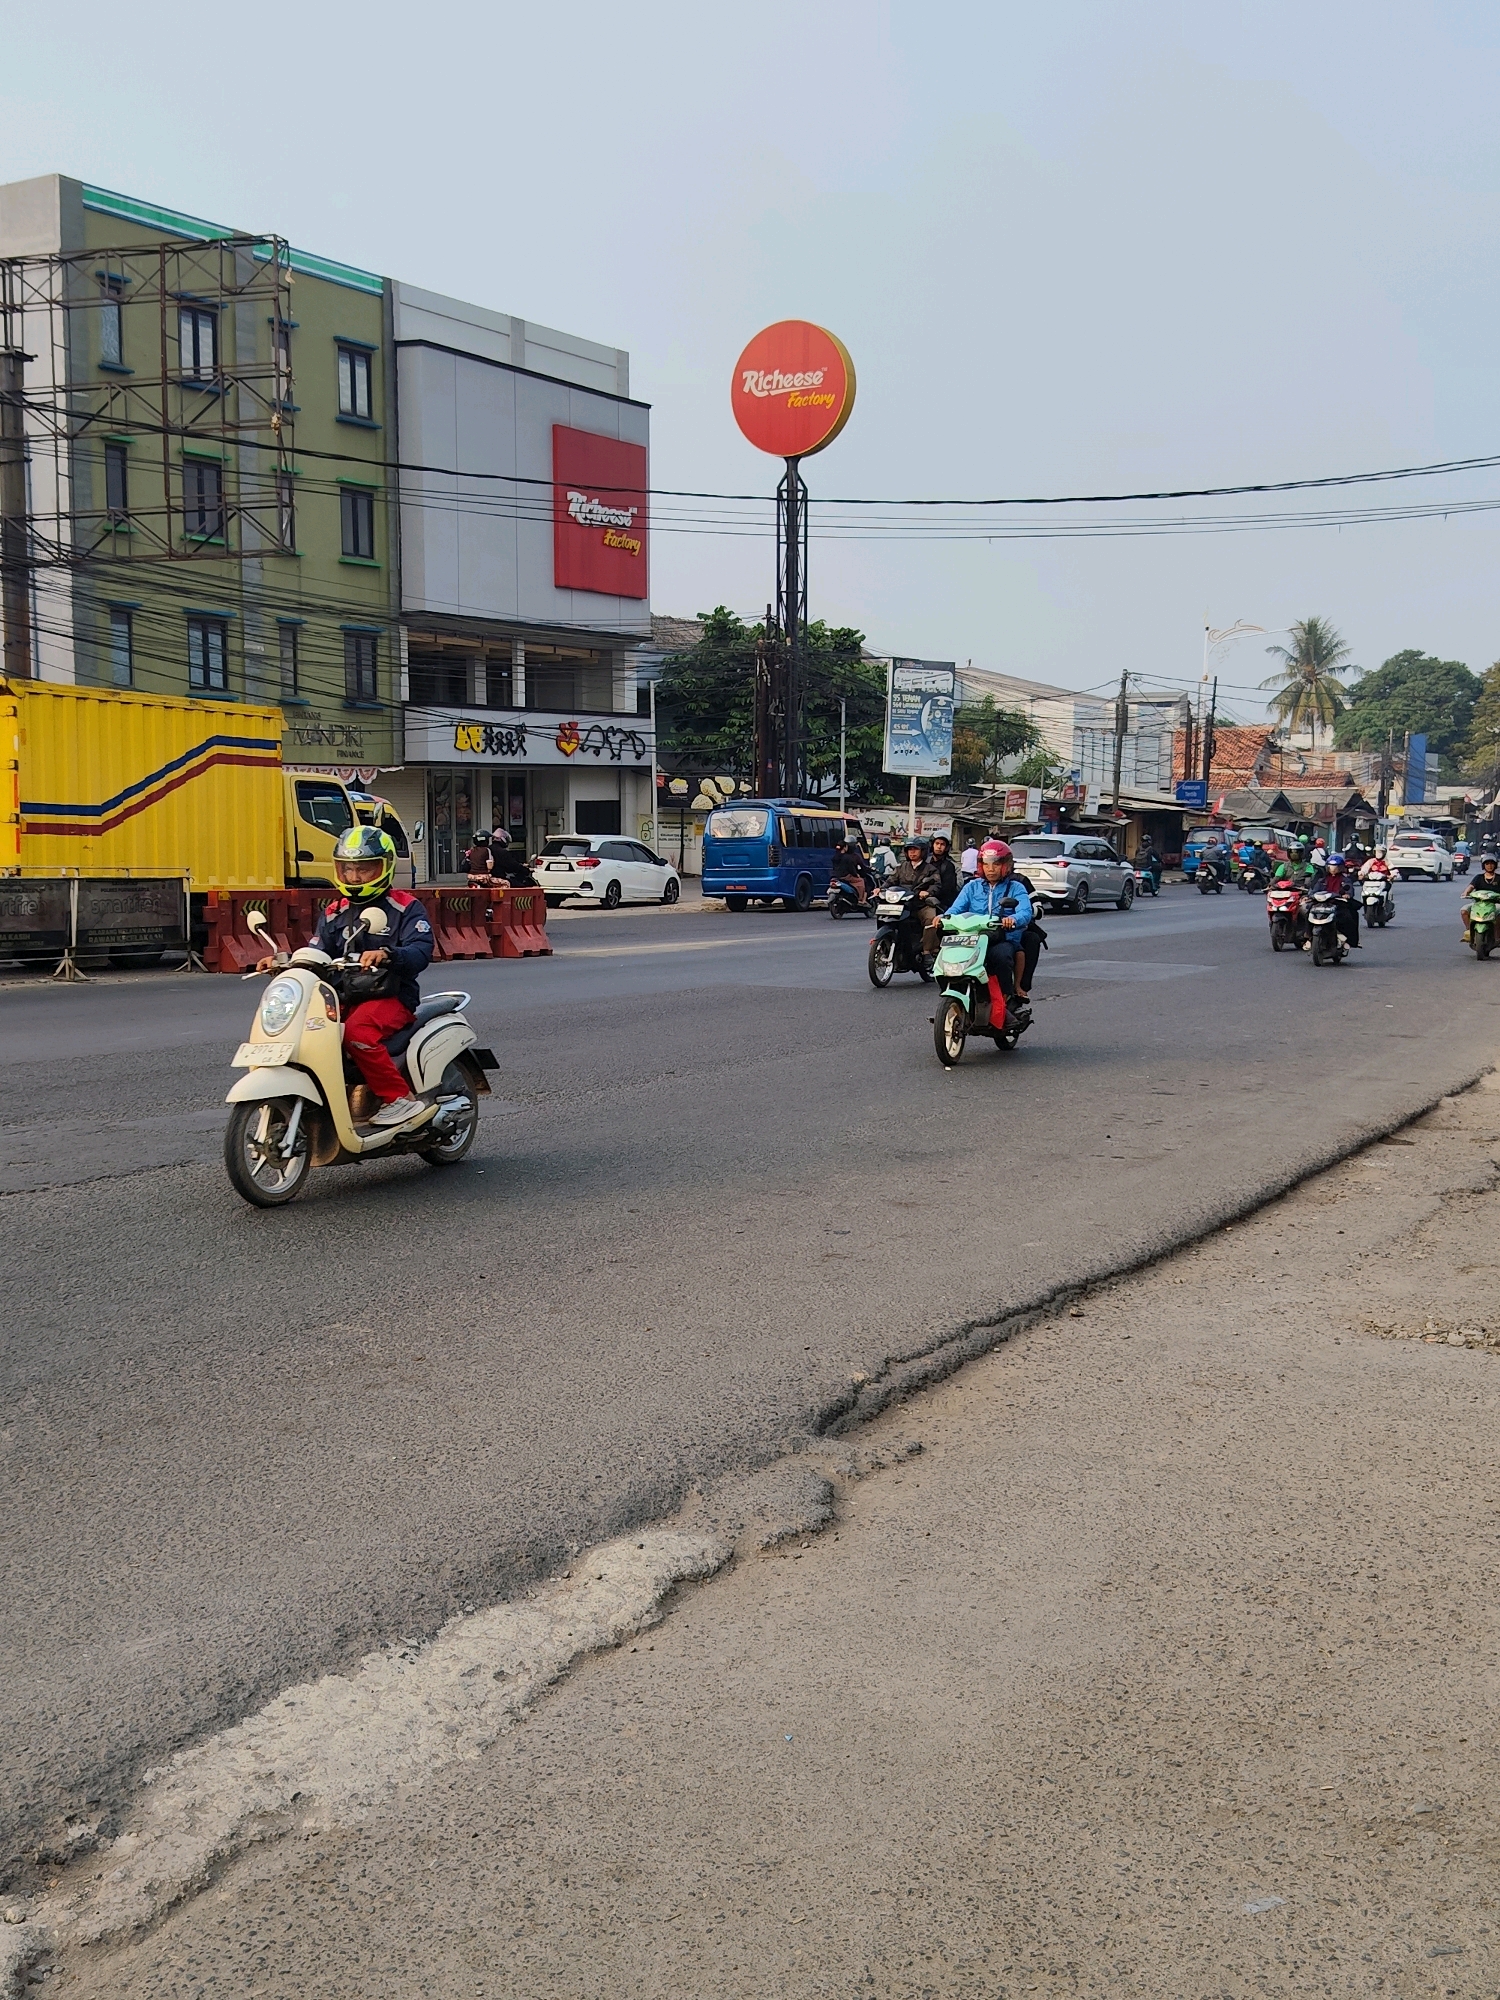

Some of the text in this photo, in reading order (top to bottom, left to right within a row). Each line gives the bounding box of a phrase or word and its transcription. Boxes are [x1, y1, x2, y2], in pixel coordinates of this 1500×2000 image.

[742, 369, 824, 398] Richeese
[787, 391, 836, 410] Factory
[566, 491, 632, 528] Richeese
[603, 528, 641, 556] Factory
[293, 722, 363, 747] MANDIRI
[336, 749, 364, 759] FINANCE
[91, 894, 161, 915] smartfren
[117, 934, 163, 942] KECELAKAAN
